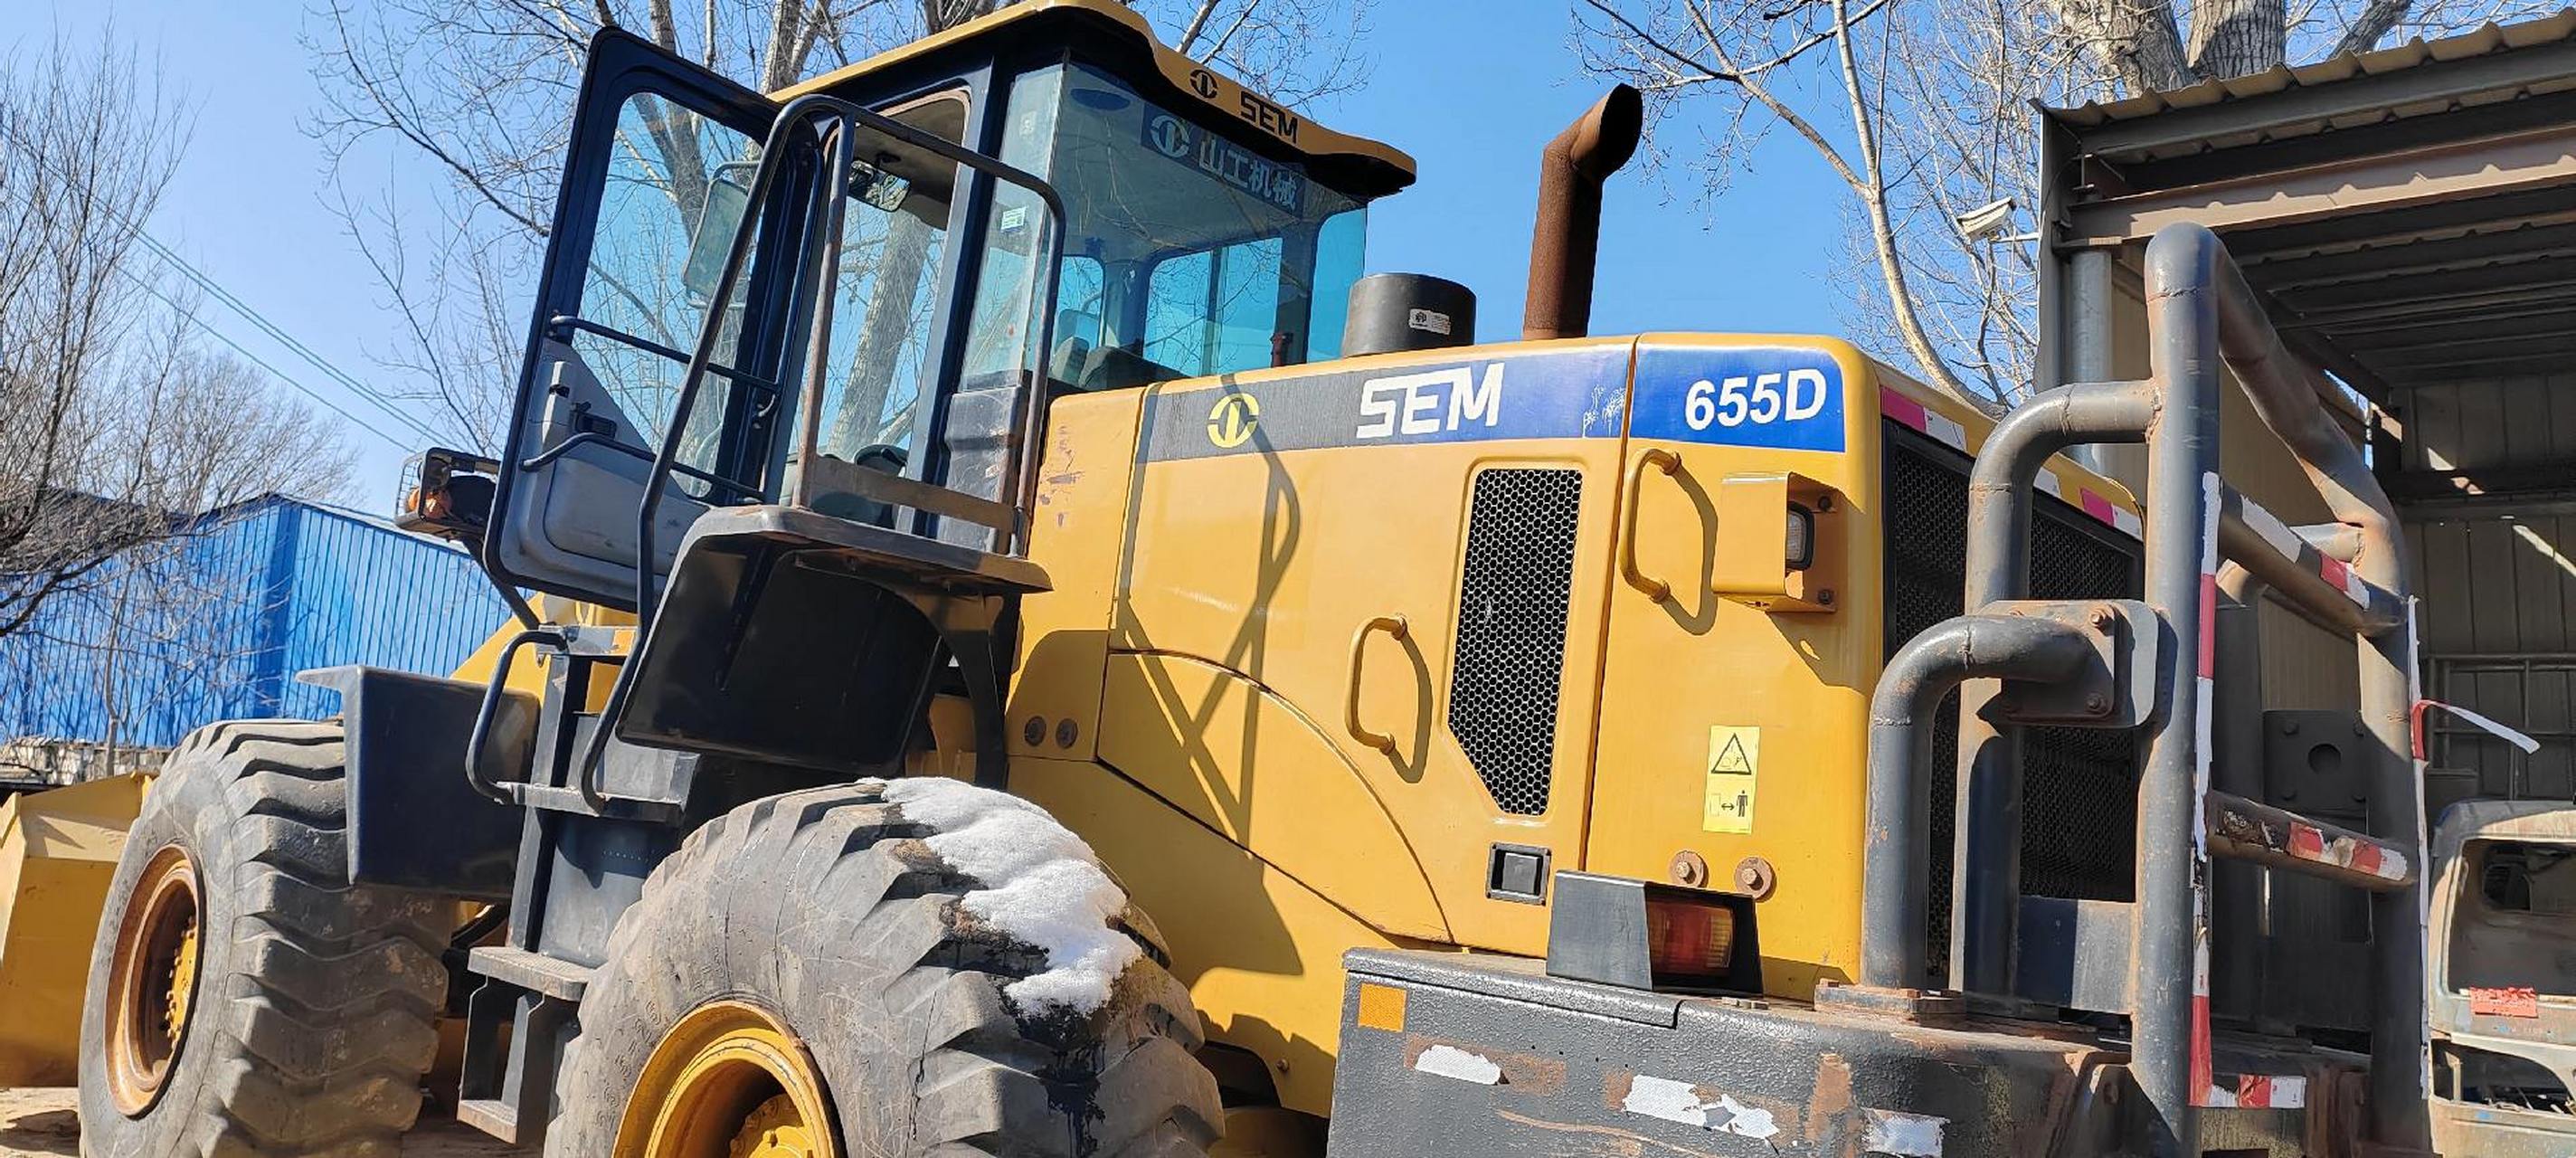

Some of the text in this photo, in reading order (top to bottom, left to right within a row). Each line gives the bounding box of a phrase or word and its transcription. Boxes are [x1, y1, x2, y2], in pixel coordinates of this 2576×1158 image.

[1241, 90, 1298, 144] SEM
[1198, 138, 1297, 210] 山工机械
[1357, 363, 1505, 438] SEM
[1685, 369, 1827, 431] 655D
